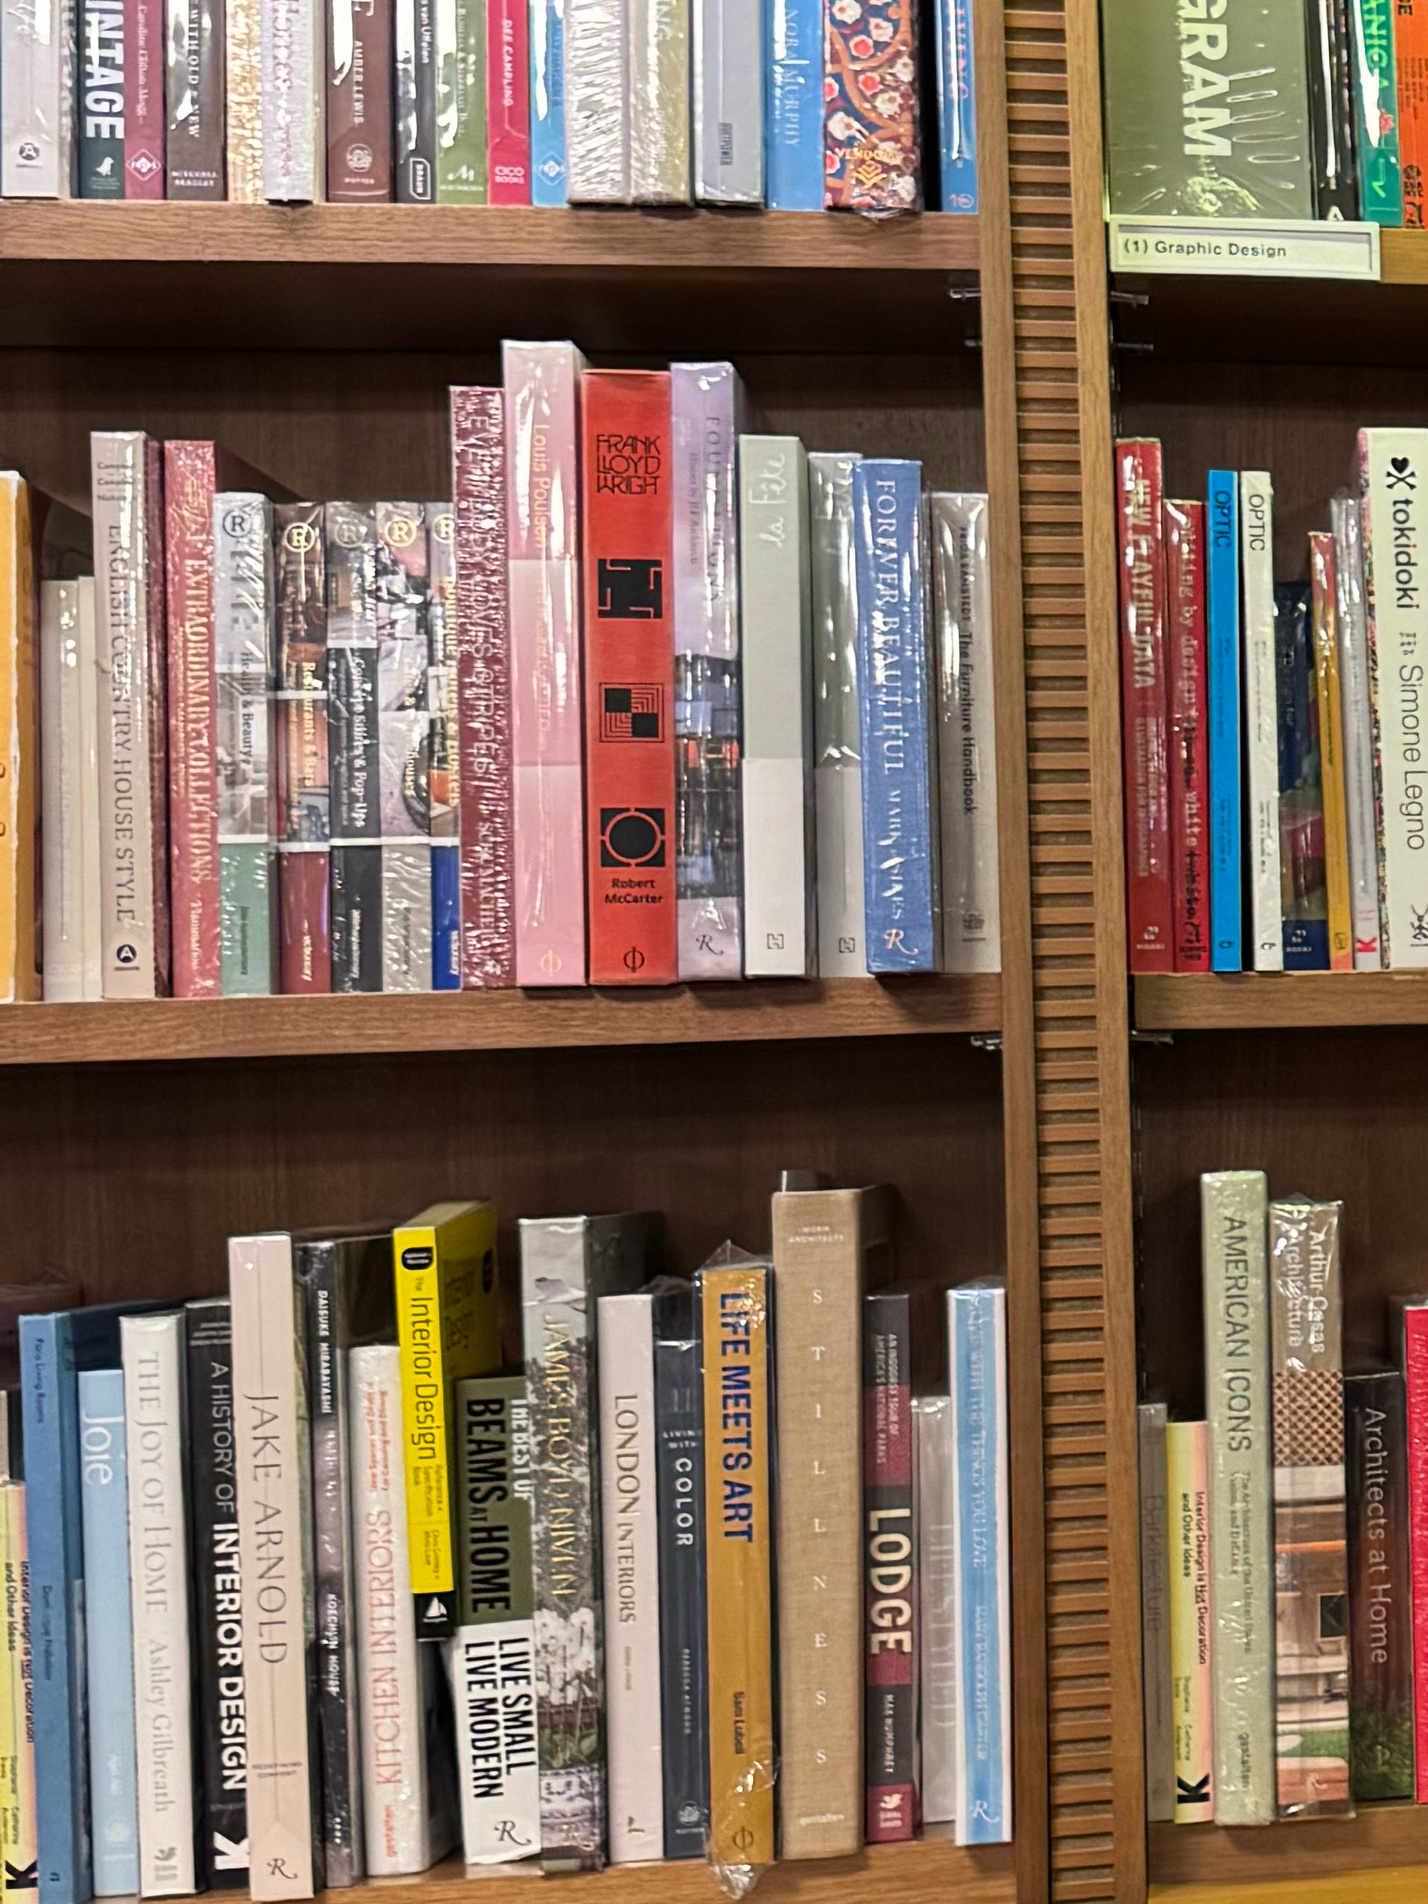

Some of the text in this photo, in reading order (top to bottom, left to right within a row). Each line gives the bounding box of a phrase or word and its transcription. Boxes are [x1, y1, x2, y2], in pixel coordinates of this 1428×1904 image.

[1122, 238, 1288, 260] (1) Graphic Design
[596, 434, 661, 454] FRANK
[1216, 490, 1231, 548] OPTIC
[1249, 494, 1265, 552] OPTIC
[1392, 497, 1422, 609] tokidoki
[1398, 665, 1427, 851] Simone Legno
[603, 892, 663, 905] McCarter
[611, 878, 655, 890] Robert
[1222, 1214, 1251, 1359] AMERICAN
[402, 1295, 438, 1462] Interior Design
[720, 1292, 754, 1544] LIFE MEETS ART
[1227, 1370, 1252, 1454] ICONS
[244, 1394, 288, 1665] JAKE ARNOLD
[465, 1398, 512, 1615] BEAMS AT HOME
[614, 1394, 641, 1627] LONDON INTERIORS
[674, 1457, 695, 1548] COLOR
[1364, 1405, 1388, 1665] Architects at Home
[210, 1362, 247, 1791] A HISTORY OF INTERIOR DESIGN
[868, 1507, 913, 1657] LODGE
[462, 1642, 505, 1800] LIVE MODERN
[498, 1637, 536, 1777] LIVE SMALL
